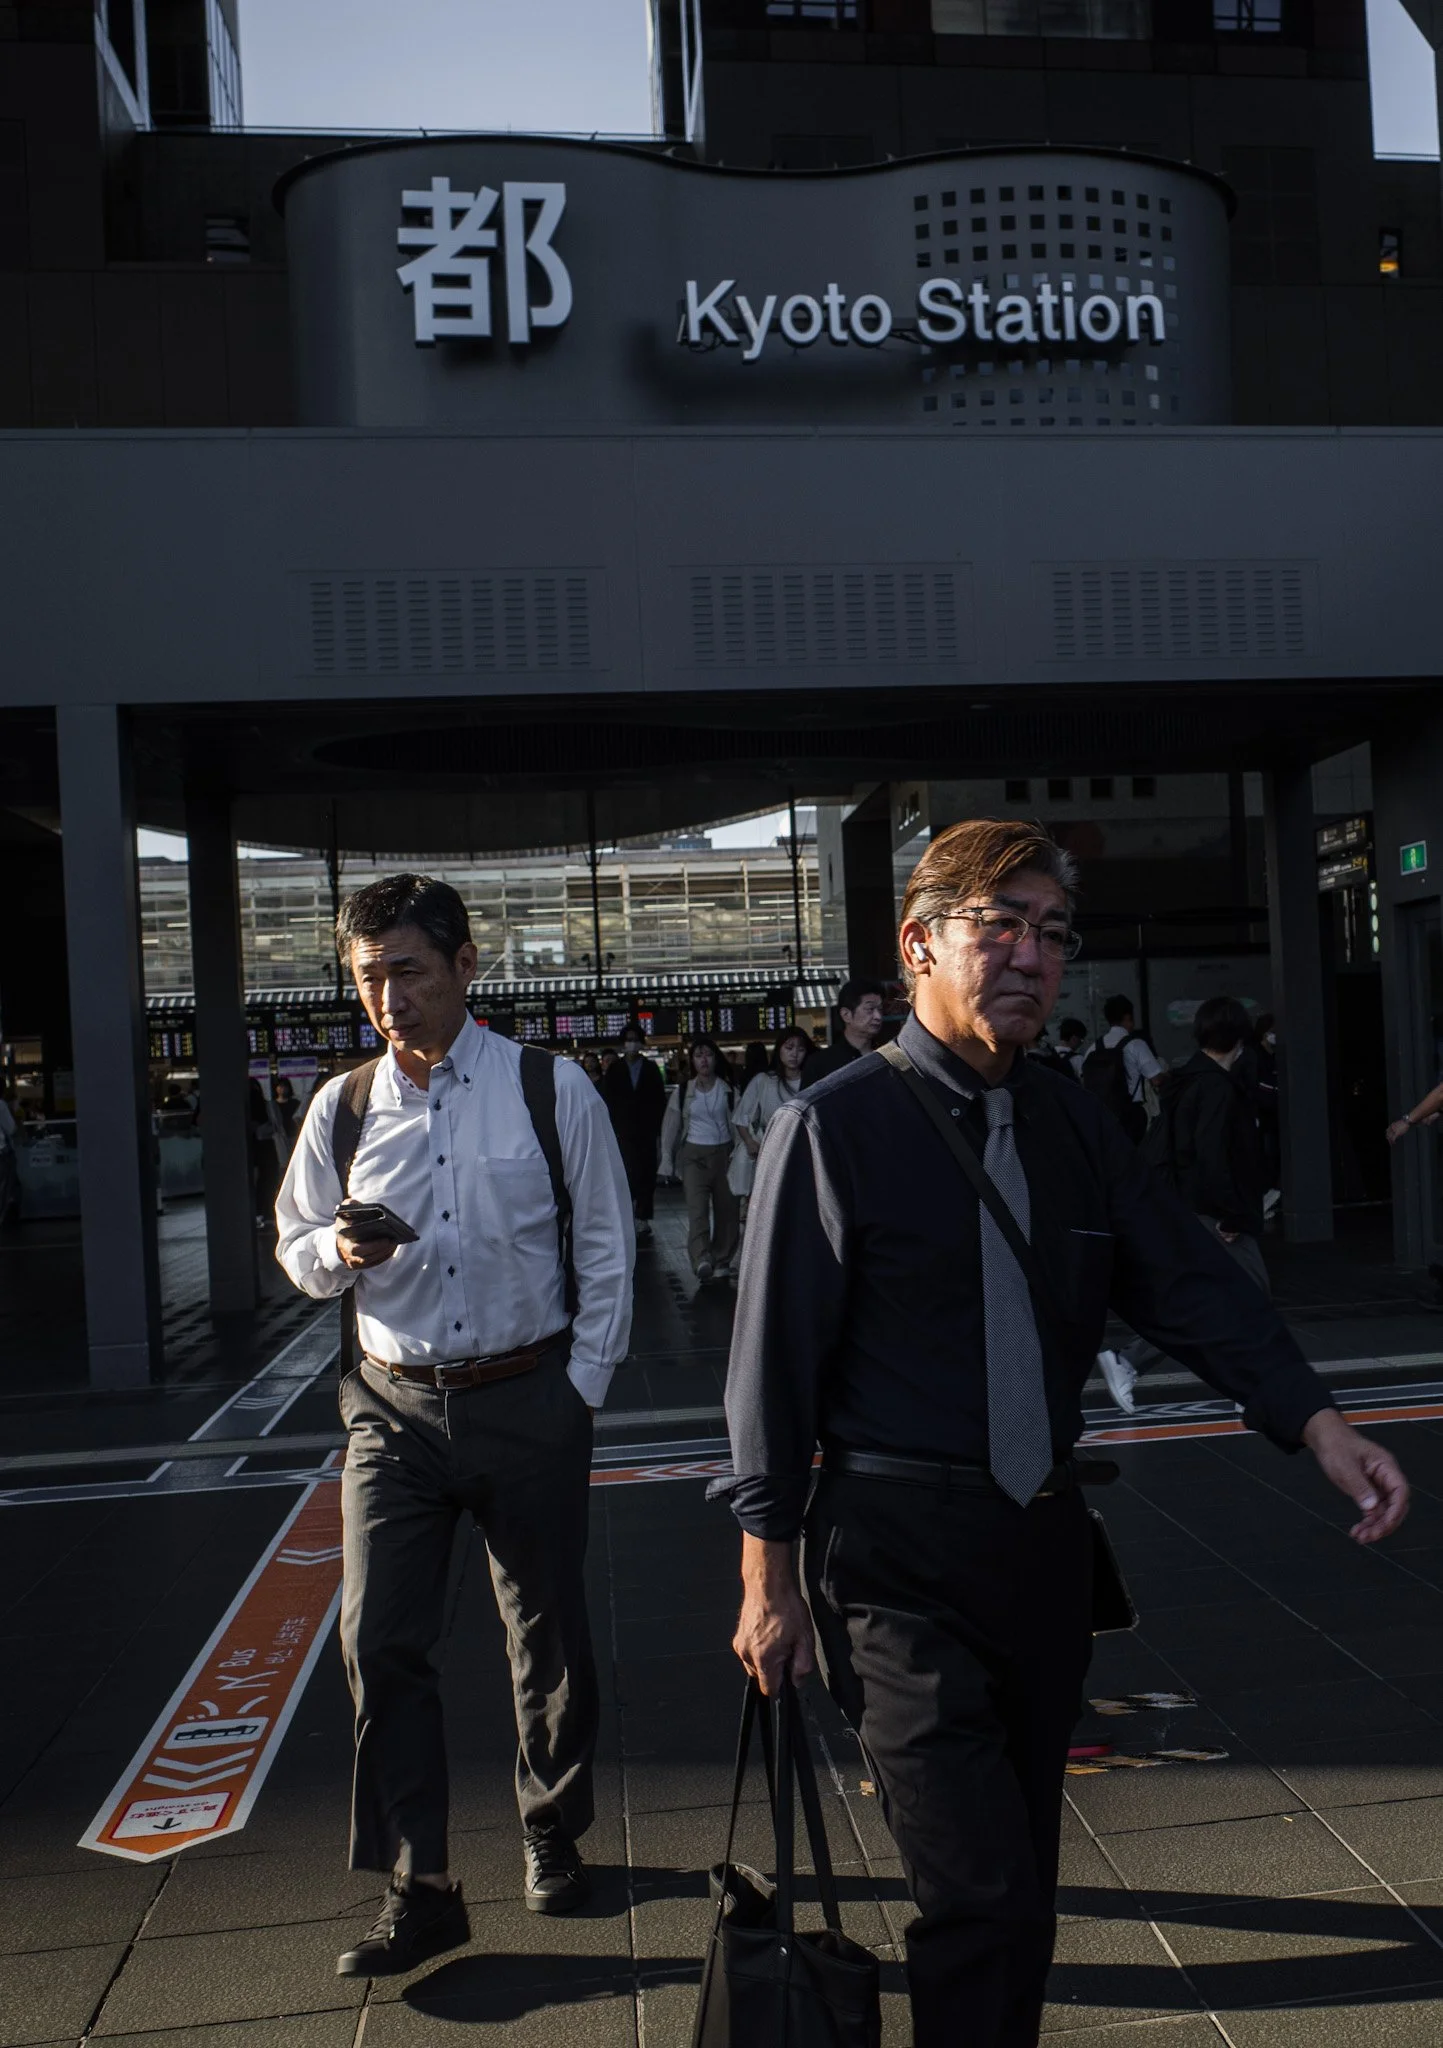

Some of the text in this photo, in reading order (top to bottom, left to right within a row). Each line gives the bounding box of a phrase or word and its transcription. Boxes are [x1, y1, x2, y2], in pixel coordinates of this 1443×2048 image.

[397, 176, 574, 346] 都
[684, 277, 1166, 363] Kyoto Station
[219, 1648, 257, 1668] Bus
[187, 1671, 279, 1720] バス
